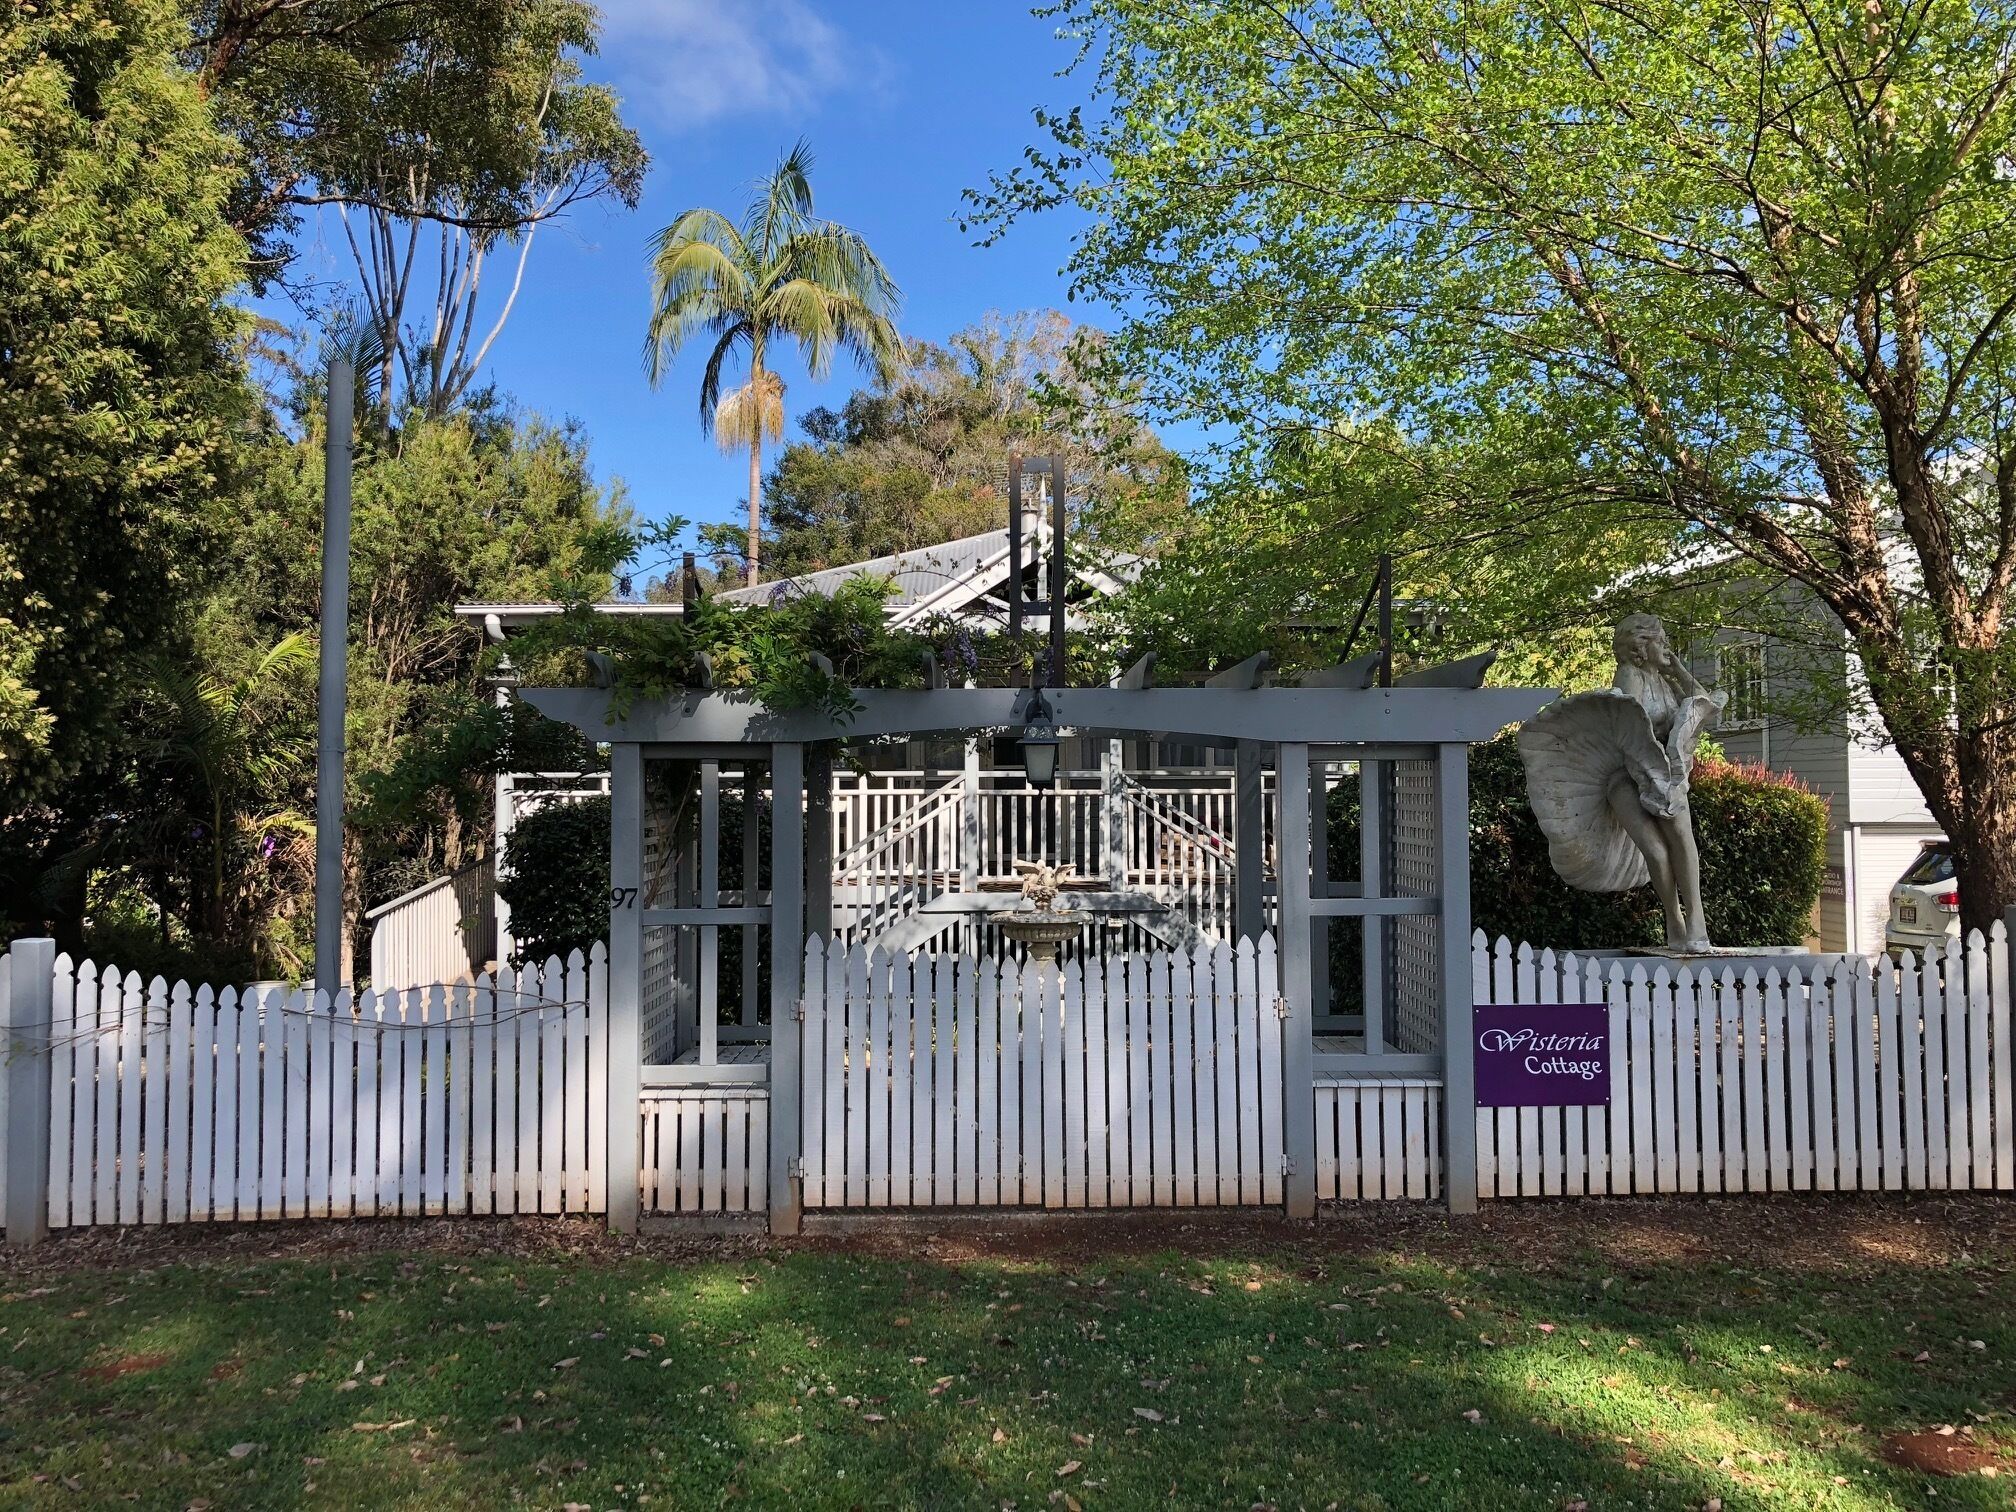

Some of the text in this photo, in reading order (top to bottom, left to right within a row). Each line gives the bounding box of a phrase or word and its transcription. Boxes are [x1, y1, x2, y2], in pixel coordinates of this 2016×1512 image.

[611, 887, 638, 909] 97
[1479, 1028, 1604, 1052] Wisteria
[1524, 1056, 1603, 1080] Cottage
